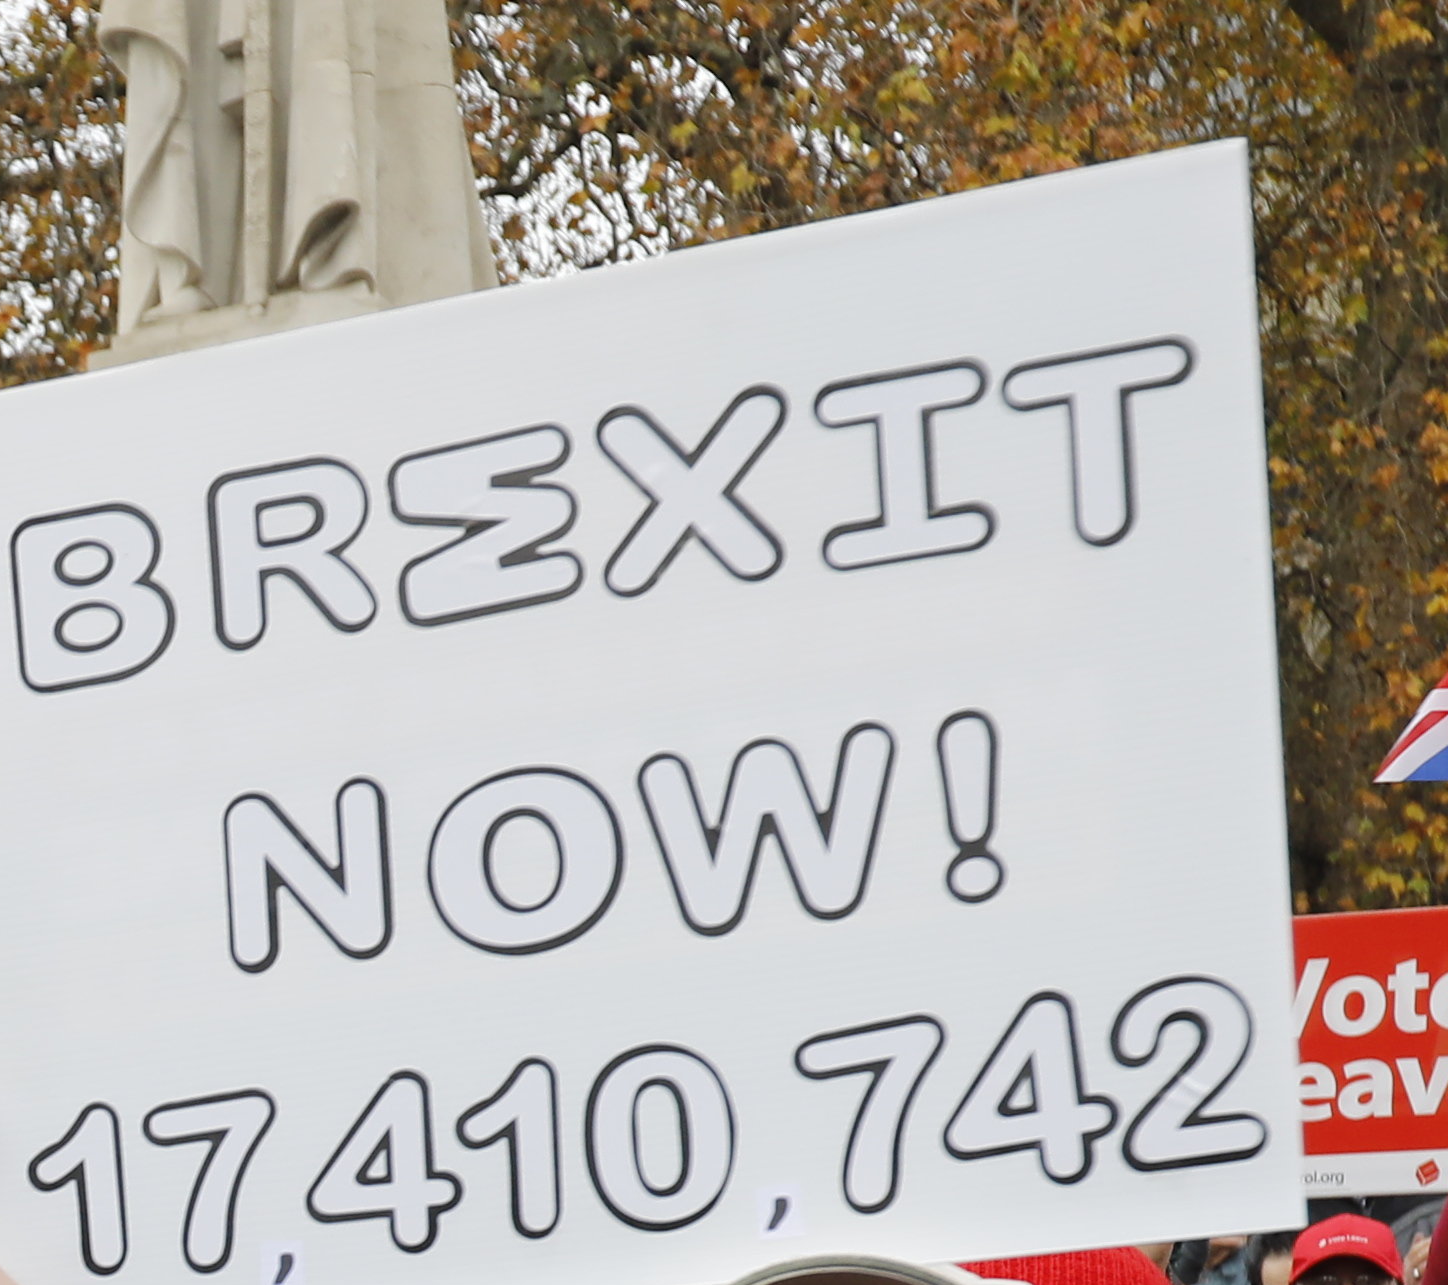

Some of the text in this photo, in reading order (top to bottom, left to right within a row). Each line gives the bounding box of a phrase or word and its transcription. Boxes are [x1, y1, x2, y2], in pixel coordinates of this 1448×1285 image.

[10, 334, 1194, 695] BREXIT
[223, 708, 1005, 974] NOW!
[1302, 1170, 1345, 1185] ol.org
